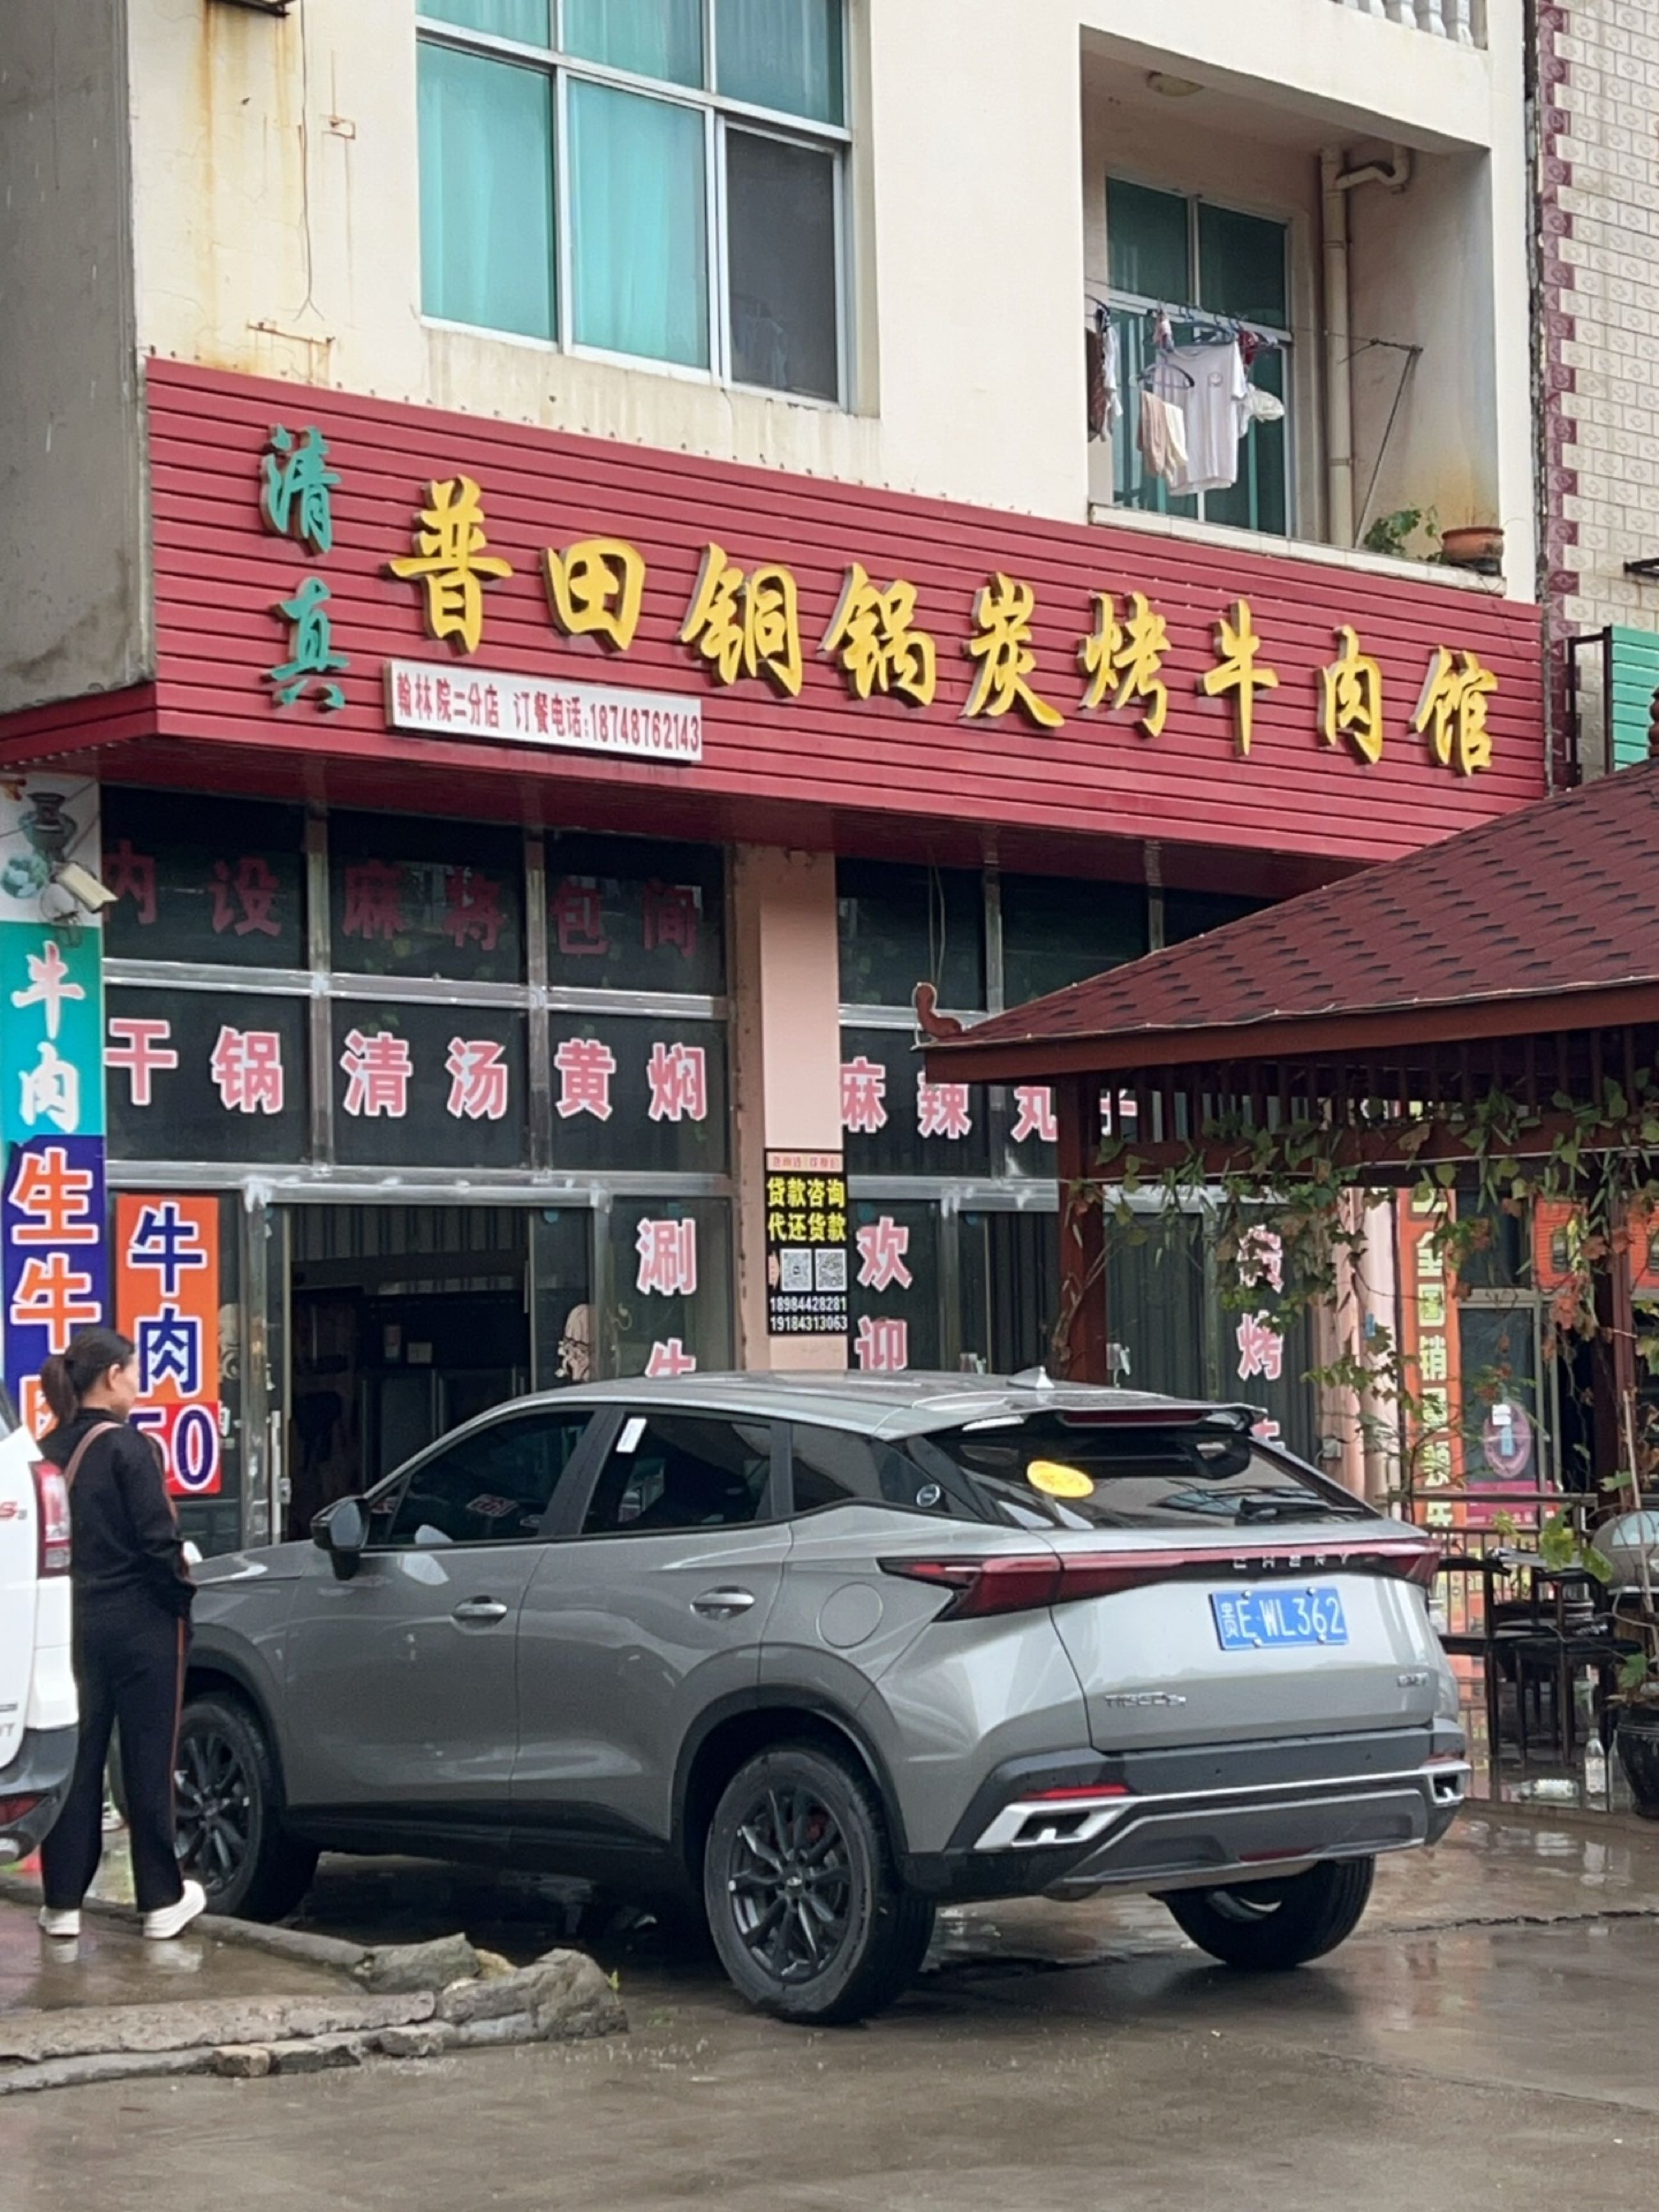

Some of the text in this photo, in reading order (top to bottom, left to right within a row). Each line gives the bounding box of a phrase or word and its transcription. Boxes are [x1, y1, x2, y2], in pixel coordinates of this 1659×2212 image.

[261, 423, 349, 710] 清真
[388, 474, 1498, 776] 普田铜锅炭烤牛肉馆
[396, 671, 499, 728] 翰林院二分店
[11, 940, 86, 1133] 牛肉
[104, 1018, 707, 1121] 干锅清汤黄焖
[127, 1201, 207, 1397] 牛肉
